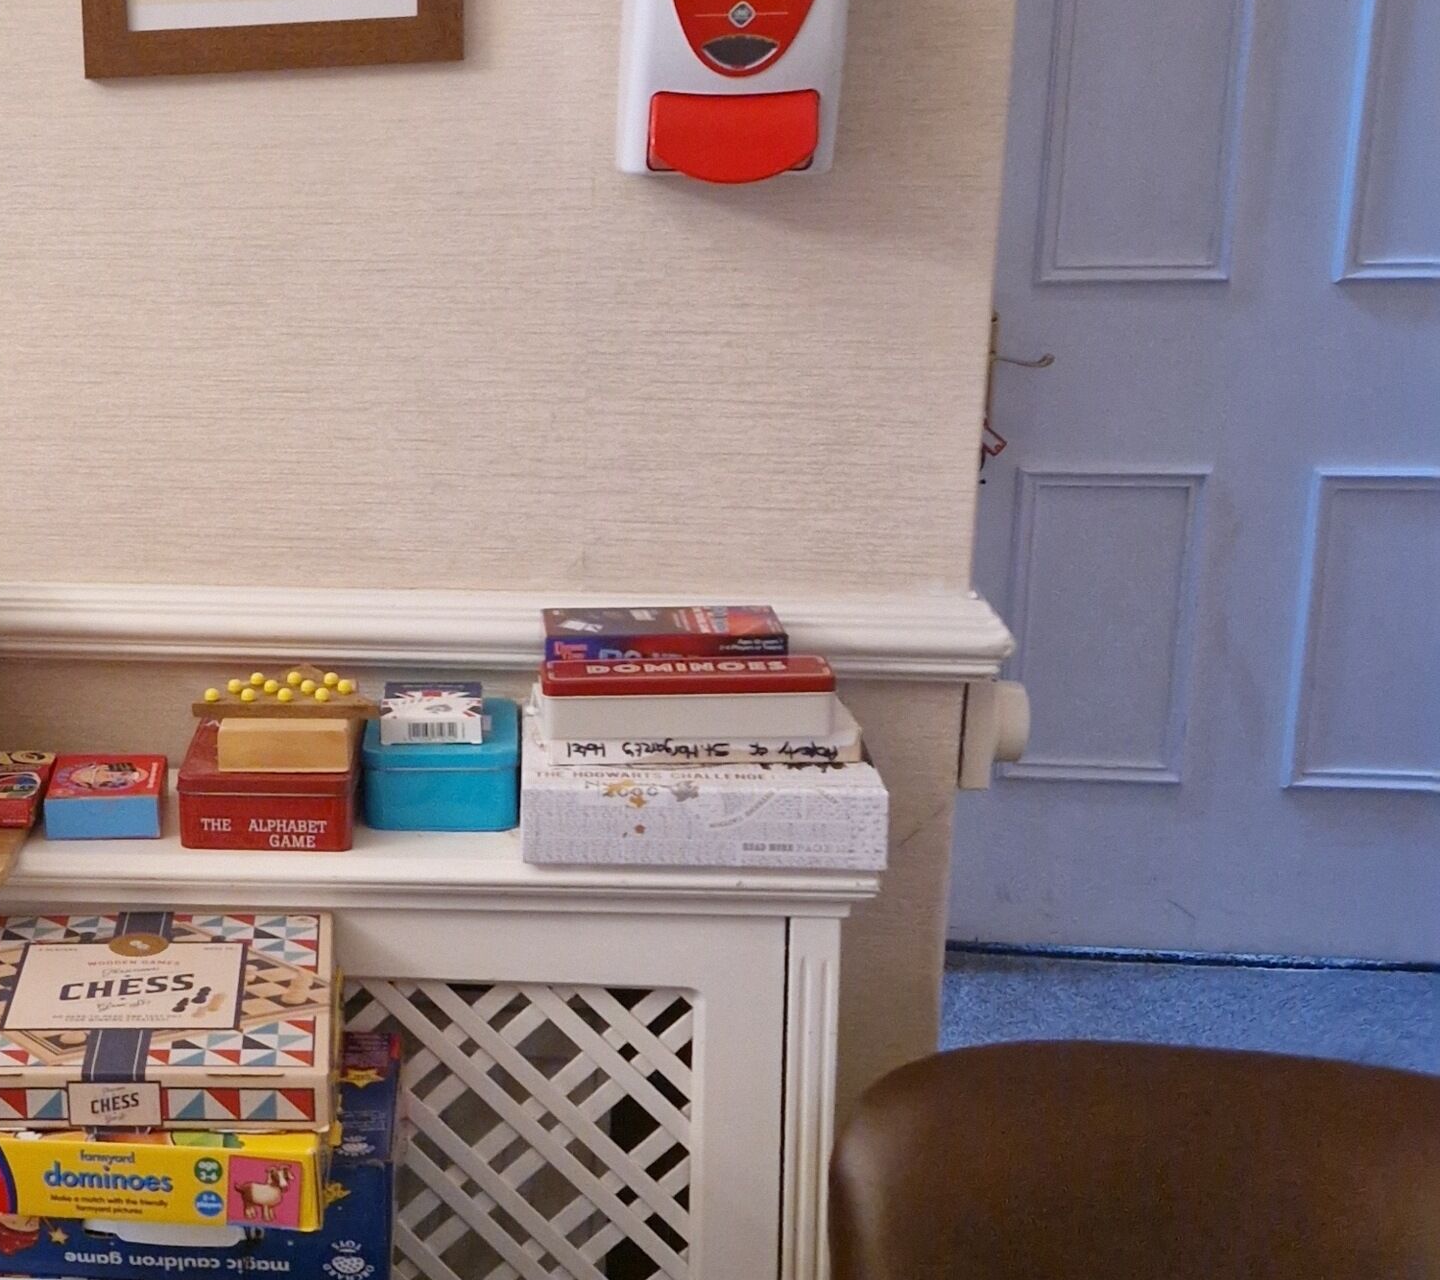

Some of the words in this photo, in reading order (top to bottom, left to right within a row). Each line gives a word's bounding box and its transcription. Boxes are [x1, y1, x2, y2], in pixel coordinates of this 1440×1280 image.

[586, 661, 787, 674] DOMINOES
[573, 771, 662, 779] HOGWARTS
[670, 772, 765, 780] CHALLENGE
[201, 818, 231, 832] THE
[248, 819, 327, 834] ALPHABET
[269, 834, 316, 848] GAME
[59, 973, 195, 1001] CHESS
[91, 1092, 140, 1115] CHESS
[80, 1150, 135, 1164] farmyard
[198, 1162, 219, 1172] age
[44, 1161, 173, 1192] dominoes
[199, 1172, 218, 1182] 3-6
[50, 1194, 72, 1203] Make
[81, 1195, 105, 1204] match
[107, 1196, 123, 1205] with
[126, 1197, 138, 1206] the
[140, 1197, 168, 1208] friendly
[76, 1204, 110, 1214] farmyard
[113, 1205, 143, 1215] pictures
[331, 1240, 362, 1251] TOYS
[64, 1251, 123, 1265] game
[129, 1255, 220, 1271] cauldron
[227, 1256, 291, 1274] magic
